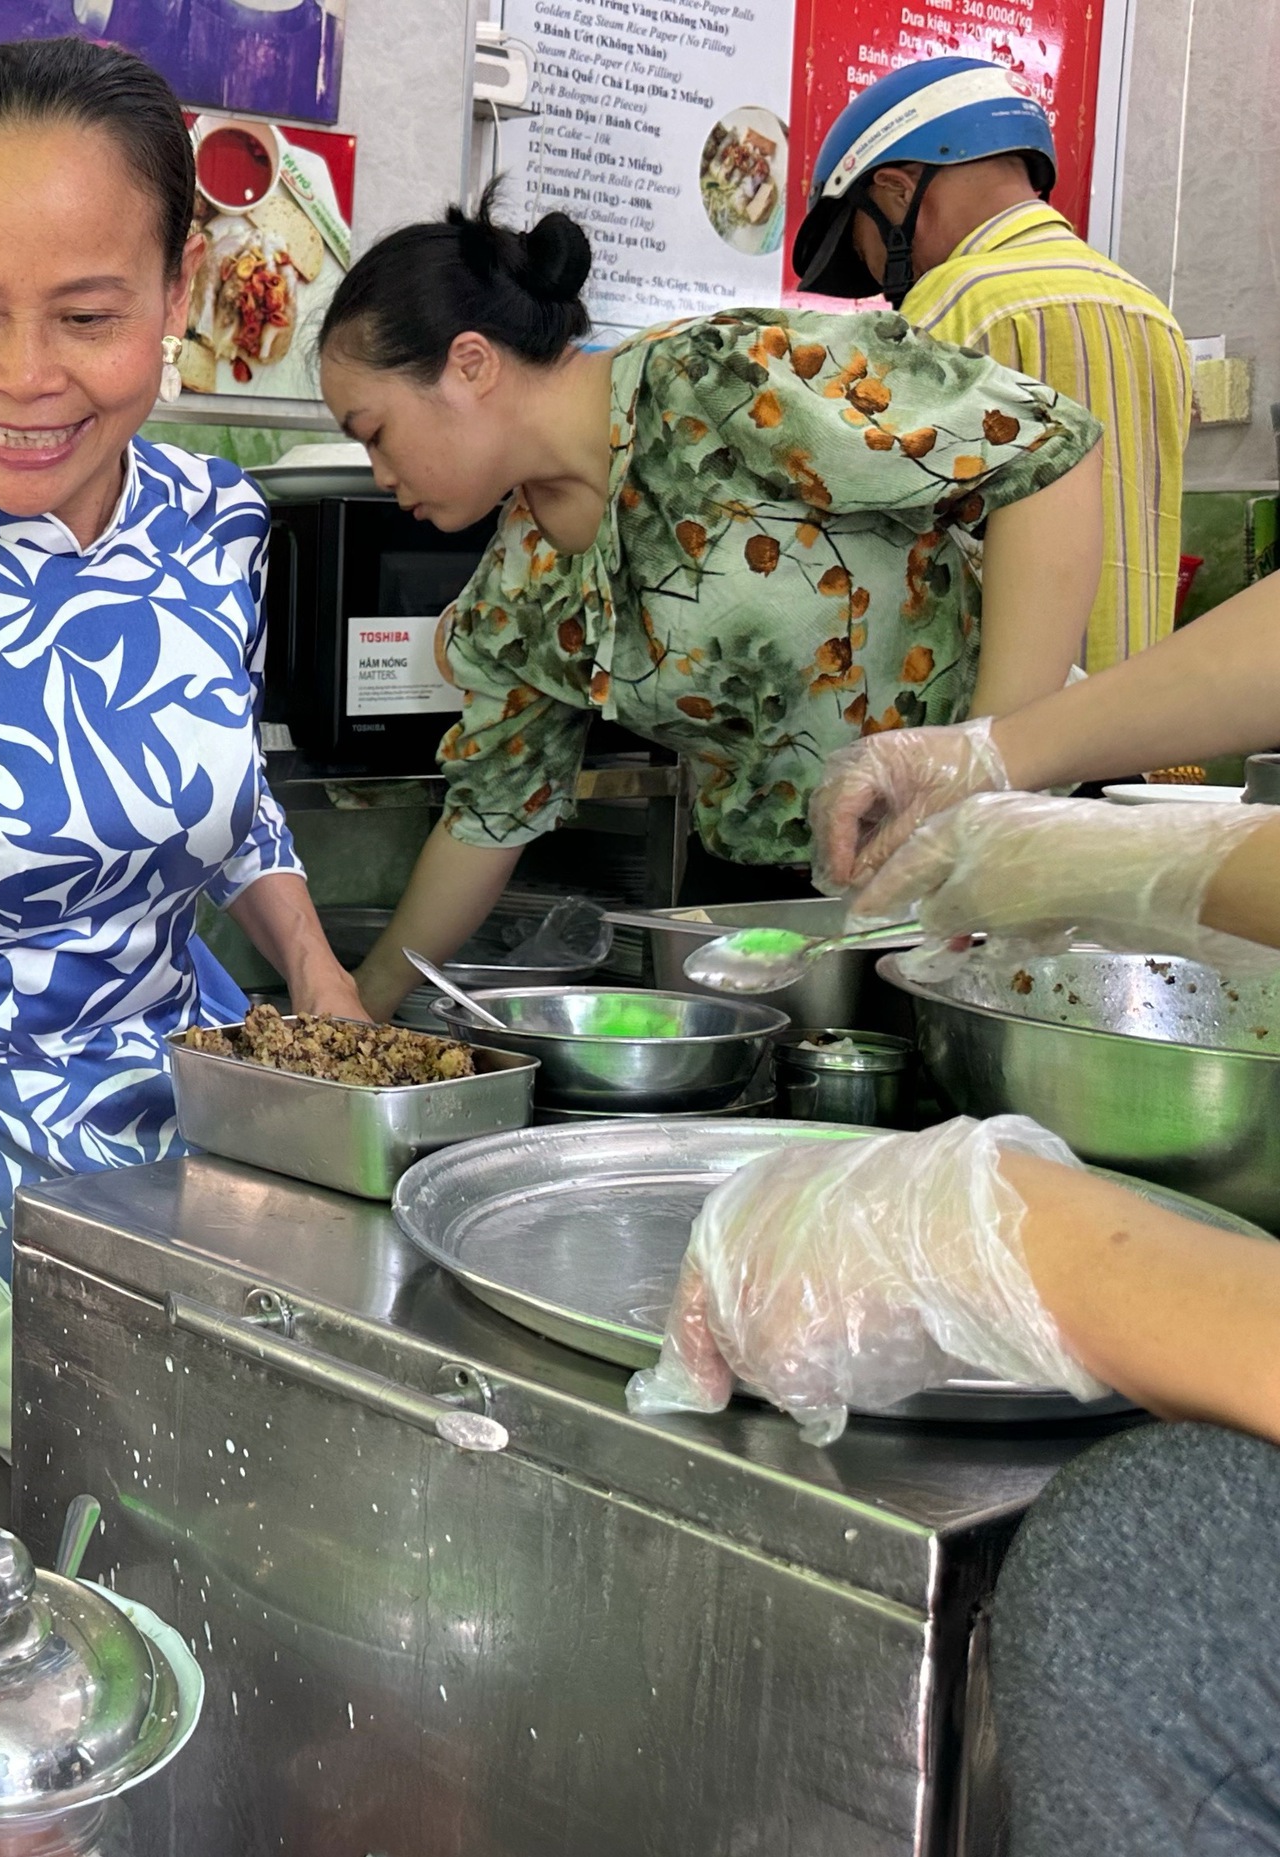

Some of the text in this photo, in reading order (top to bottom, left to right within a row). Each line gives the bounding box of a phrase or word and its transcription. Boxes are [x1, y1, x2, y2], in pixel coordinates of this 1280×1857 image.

[731, 6, 755, 21] Rolls
[534, 1, 572, 20] Golden
[573, 9, 594, 28] Egg
[594, 14, 625, 32] Steam
[626, 21, 649, 37] Rice
[649, 26, 679, 44] Paper
[858, 44, 889, 67] Bánh
[556, 125, 583, 141] Cake
[525, 160, 582, 181] Femented
[359, 632, 410, 643] TOSHIBA
[352, 724, 386, 732] TOSHIBA
